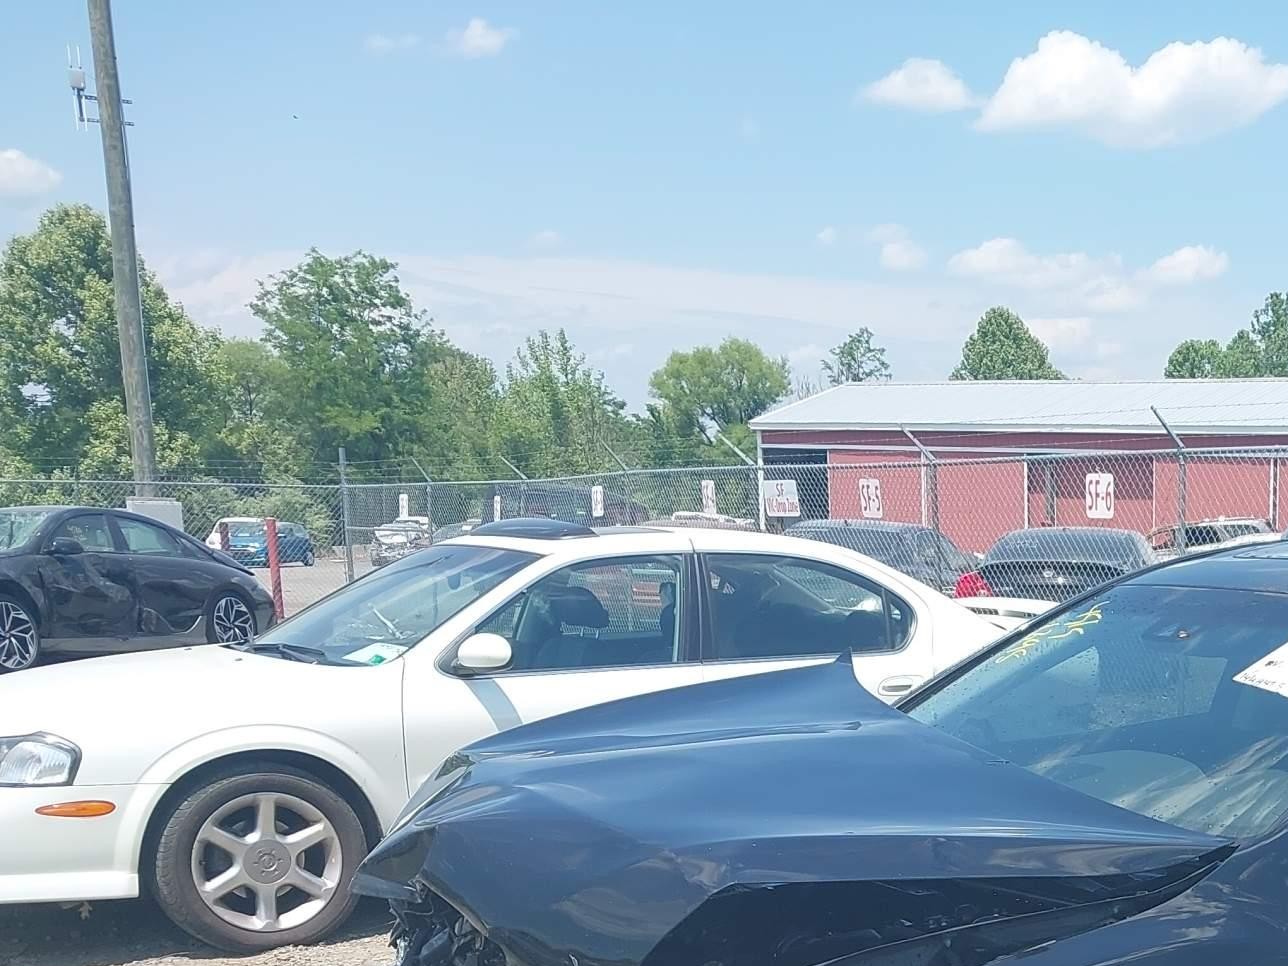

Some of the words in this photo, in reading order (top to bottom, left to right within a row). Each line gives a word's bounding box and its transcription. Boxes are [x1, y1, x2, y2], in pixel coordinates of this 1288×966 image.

[775, 482, 785, 498] SF
[861, 484, 881, 512] SF-5
[1088, 479, 1112, 512] SF-6
